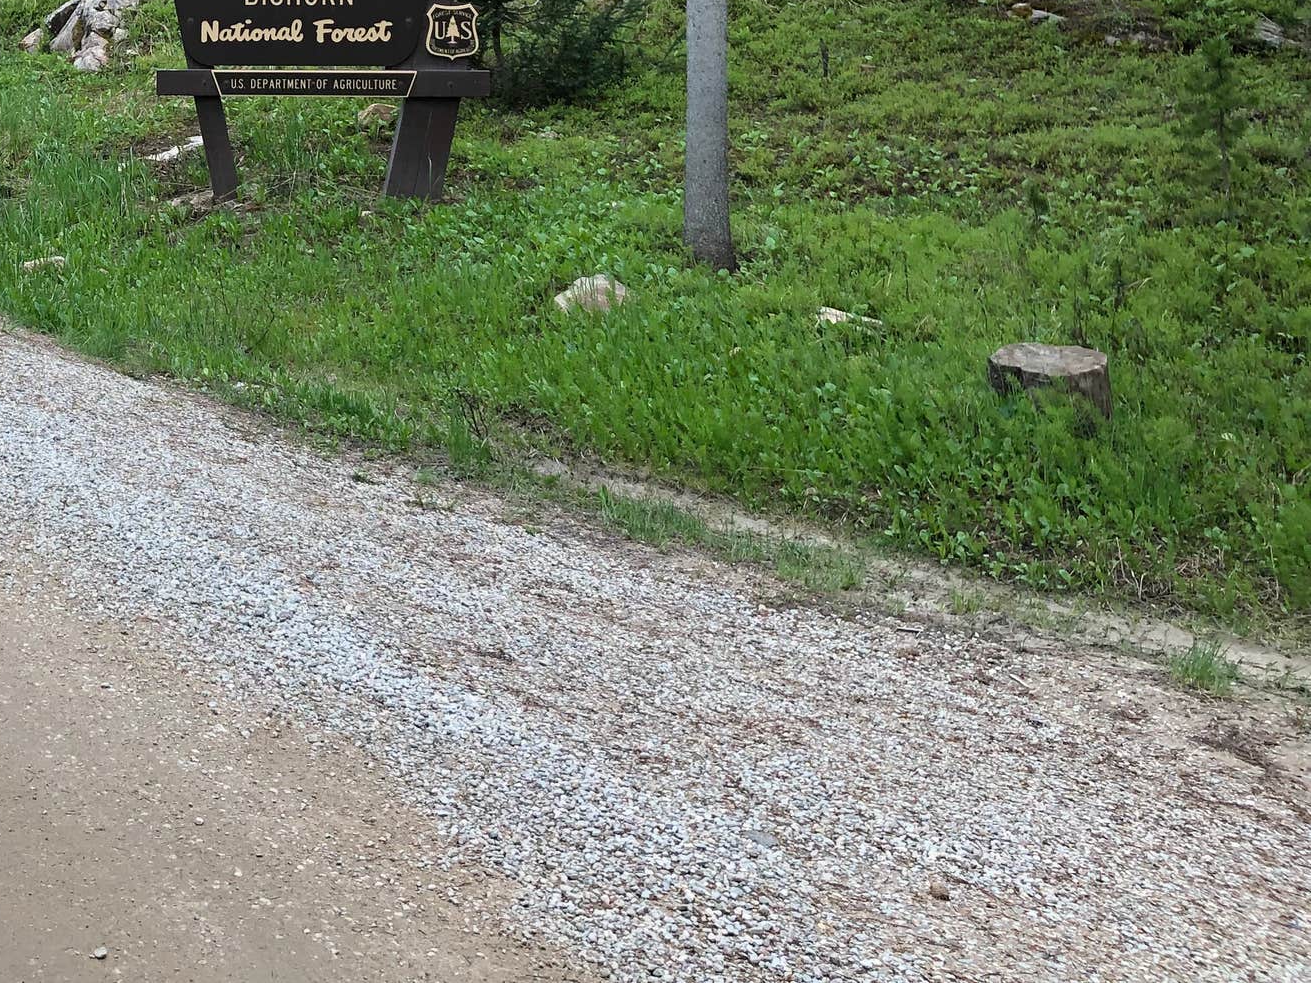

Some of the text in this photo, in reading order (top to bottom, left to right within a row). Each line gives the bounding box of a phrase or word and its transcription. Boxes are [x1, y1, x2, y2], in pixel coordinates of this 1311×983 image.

[201, 19, 393, 43] National Forest
[230, 78, 397, 90] U.S. DEPARTMENT OF AGRICULTURE
